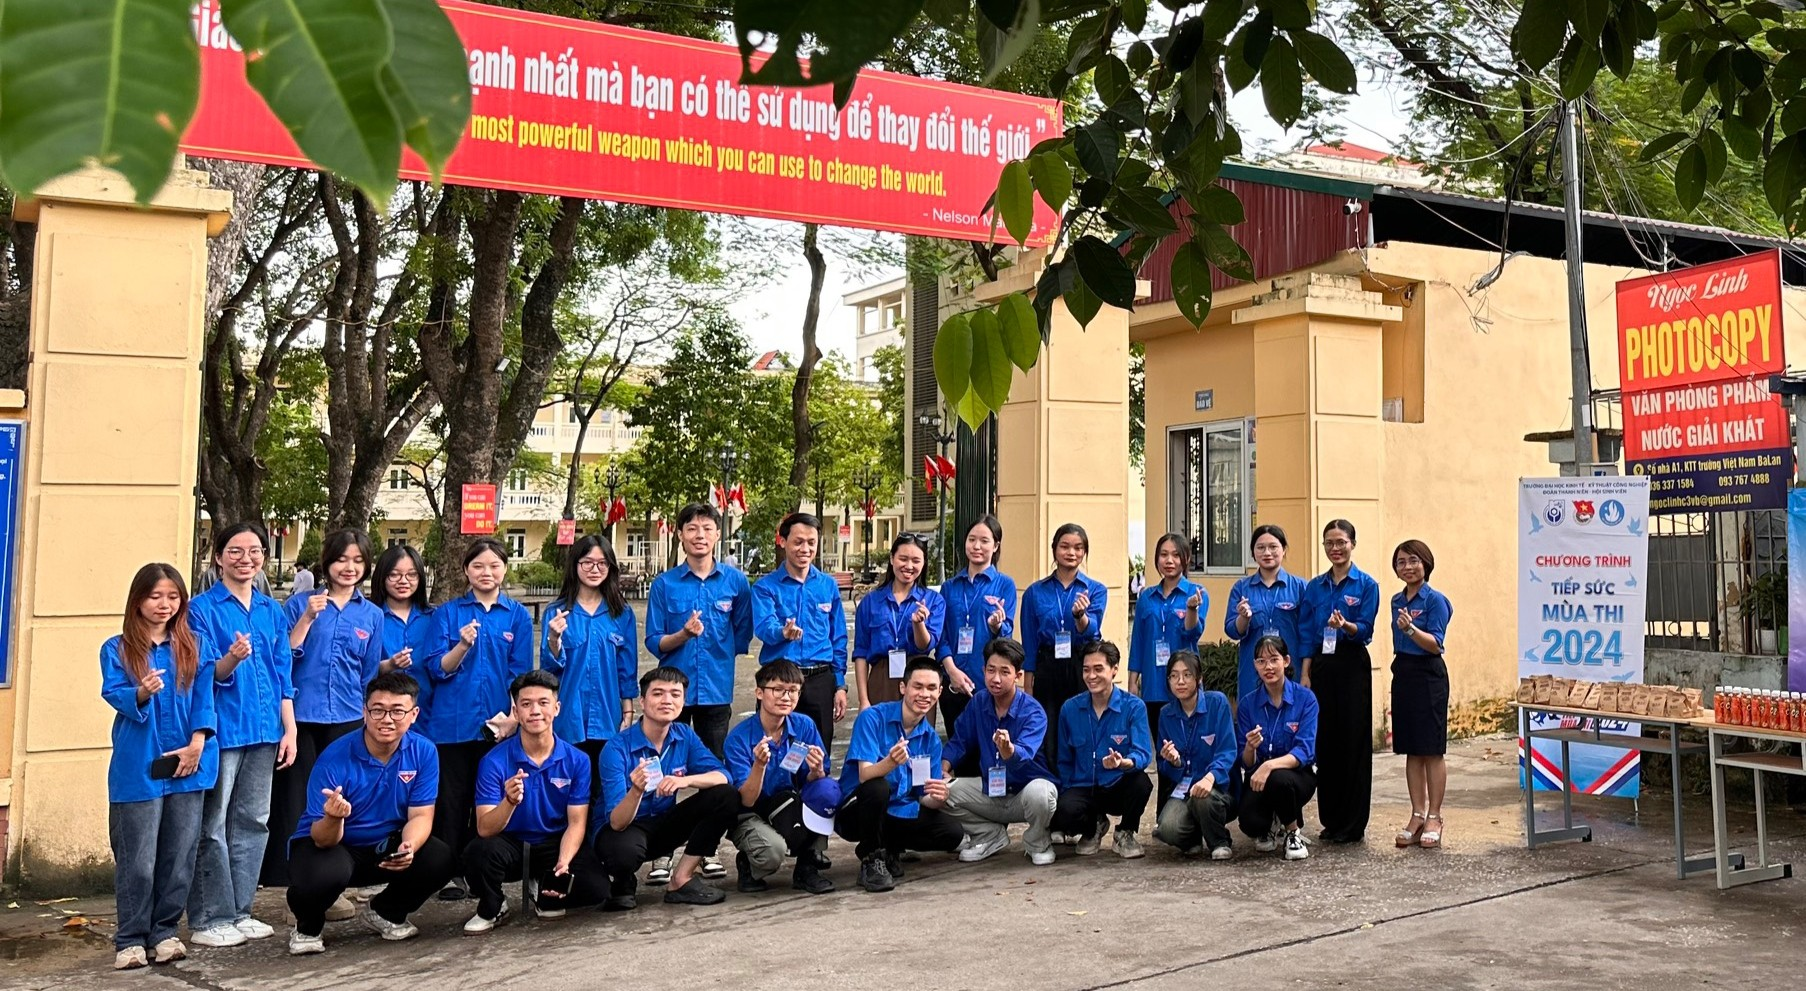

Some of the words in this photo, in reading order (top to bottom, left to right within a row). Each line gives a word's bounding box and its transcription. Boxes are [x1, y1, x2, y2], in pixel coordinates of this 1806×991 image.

[467, 45, 516, 95] ạnh
[524, 47, 579, 100] nhất
[585, 60, 623, 105] mà
[630, 65, 674, 119] bạn
[681, 75, 709, 117] có
[789, 91, 840, 141] dụng
[847, 92, 873, 140] để
[878, 105, 920, 152] thay
[926, 106, 955, 152] đổi
[961, 113, 992, 157] thế
[996, 124, 1030, 164] giới
[471, 114, 514, 144] most
[518, 120, 593, 153] powerful
[597, 130, 661, 162] weapon
[665, 136, 713, 168] which
[717, 146, 743, 173] you
[747, 150, 775, 176] can
[779, 154, 805, 179] use
[808, 154, 822, 182] to
[826, 156, 877, 191] change
[880, 164, 902, 192] the
[905, 170, 947, 197] world.
[932, 208, 979, 226] Nelson
[1647, 282, 1697, 312] Ngọc
[1700, 267, 1749, 300] Linh
[1625, 304, 1772, 381] PHOTOCOPY
[1631, 389, 1661, 417] VĂN
[1665, 383, 1718, 413] PHÒNG
[1722, 372, 1772, 405] PHẨM
[1641, 425, 1682, 451] NƯỚC
[1686, 416, 1718, 447] GIẢI
[1723, 414, 1765, 444] KHÁT
[1657, 463, 1670, 474] nhà
[1684, 460, 1697, 472] KTT
[1722, 457, 1737, 471] Việt
[1738, 457, 1756, 468] Nam
[1757, 454, 1781, 466] BaLan
[1662, 480, 1674, 490] 337
[1677, 478, 1694, 489] 1584
[1718, 476, 1733, 487] 093
[1734, 474, 1748, 486] 767
[1750, 473, 1770, 484] 4888
[1536, 554, 1591, 567] CHƯƠNG
[1594, 553, 1631, 567] TRÌNH
[1551, 576, 1580, 595] TIẾP
[1584, 578, 1615, 595] SỨC
[1542, 600, 1588, 623] MÙA
[1593, 605, 1624, 623] THI
[1541, 628, 1624, 666] 2024
